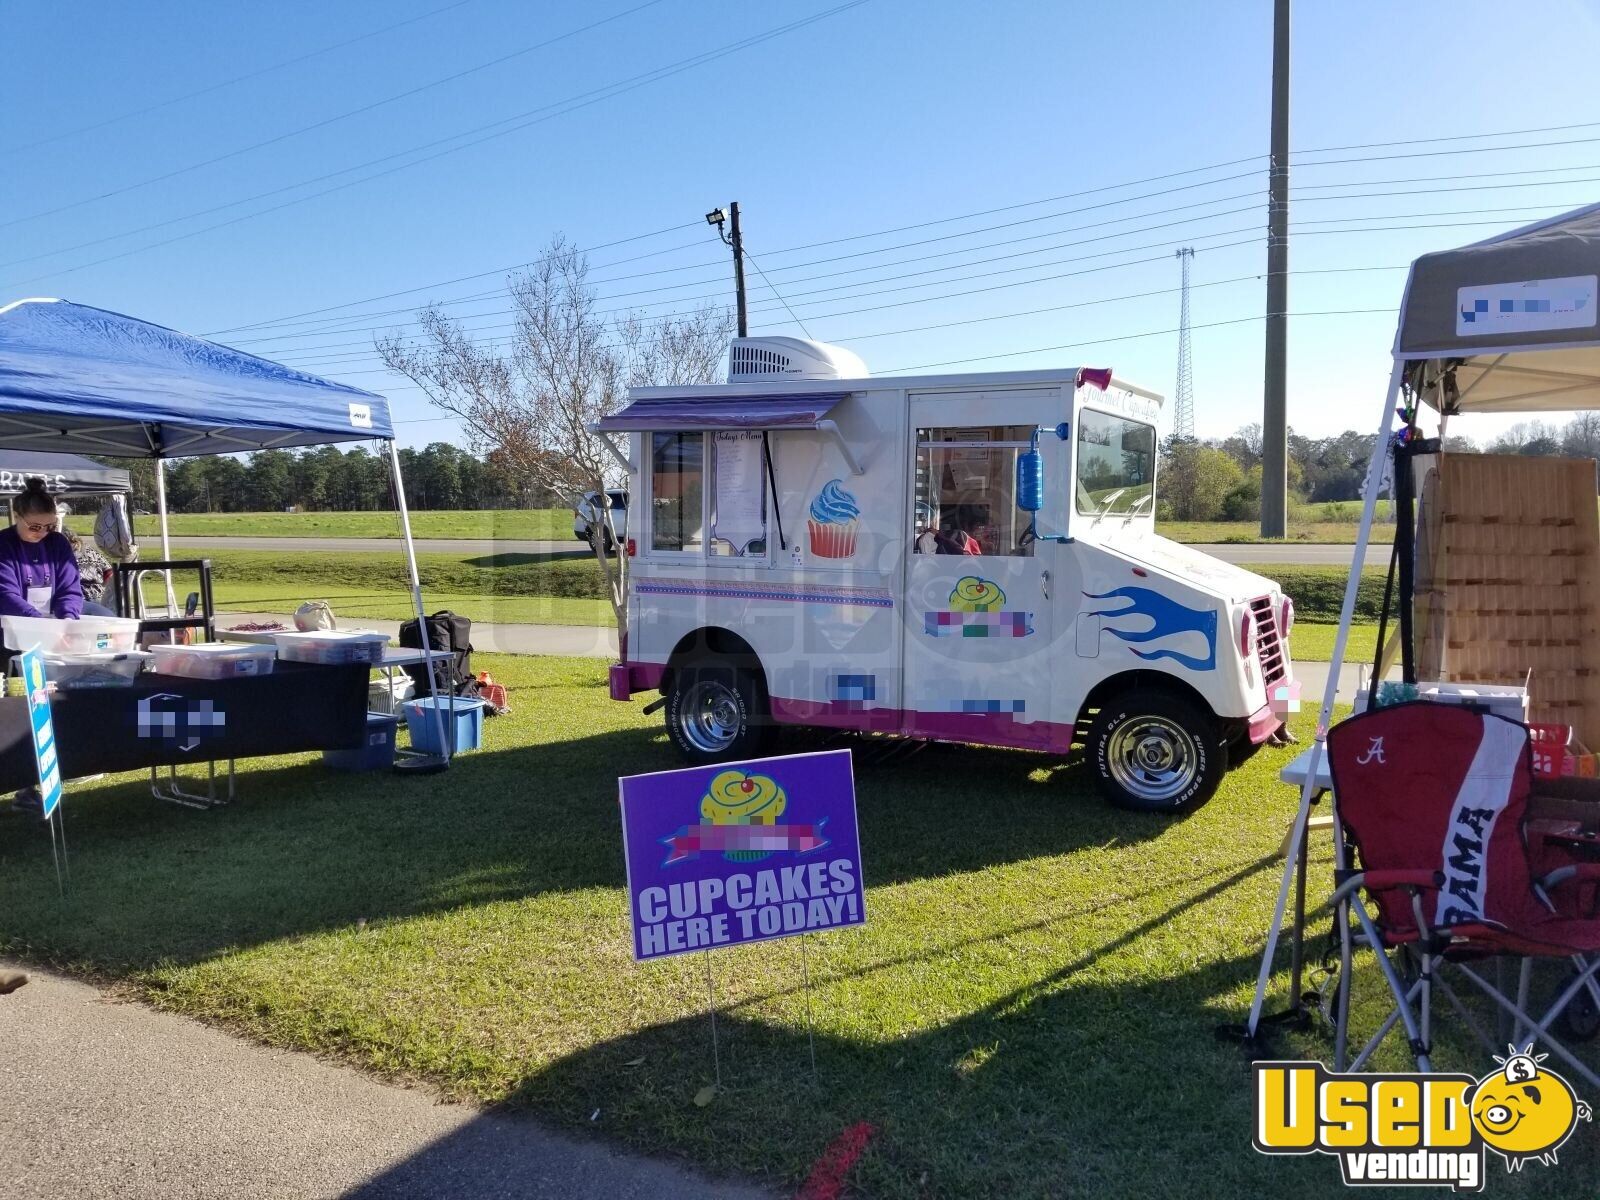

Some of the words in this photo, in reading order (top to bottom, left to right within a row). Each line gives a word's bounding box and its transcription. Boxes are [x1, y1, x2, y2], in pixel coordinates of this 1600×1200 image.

[740, 430, 762, 440] Menu
[1098, 734, 1109, 778] FUTURA
[1107, 713, 1126, 731] GLS
[1193, 734, 1206, 772] SUPER
[1356, 736, 1386, 765] A
[1174, 775, 1203, 806] SPORT
[638, 858, 855, 924] CUPCAKES
[640, 913, 730, 956] HERE
[736, 893, 859, 939] TODAY!
